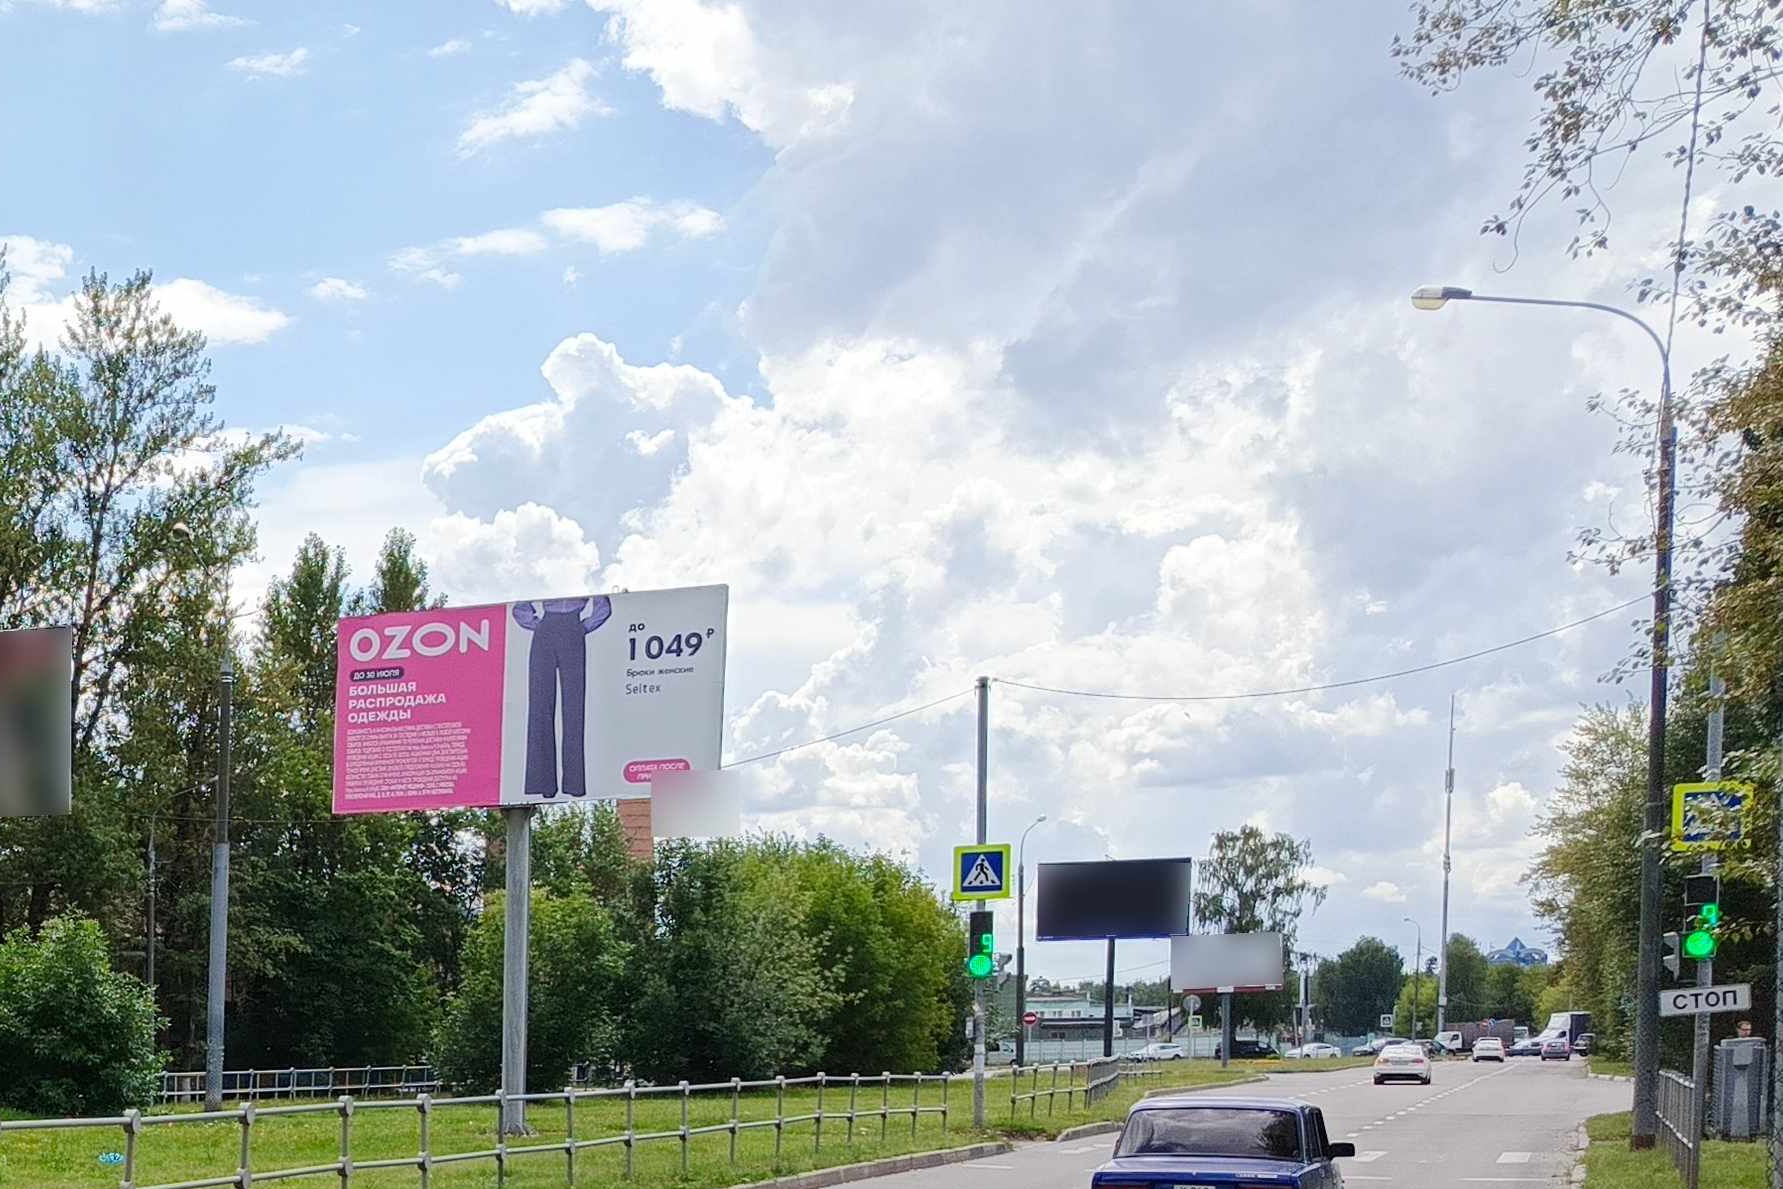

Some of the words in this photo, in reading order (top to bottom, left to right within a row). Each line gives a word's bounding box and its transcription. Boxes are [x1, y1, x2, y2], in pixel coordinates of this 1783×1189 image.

[628, 623, 646, 633] до
[349, 619, 490, 662] OZON
[353, 671, 365, 680] ДО
[626, 668, 655, 678] Брюки
[658, 667, 694, 675] женские
[348, 682, 416, 696] БОЛЬШАЯ
[625, 682, 662, 695] Seltex
[348, 693, 447, 710] РАСПРОДАЖА
[348, 710, 411, 723] ОДЕЖДЫ
[982, 933, 993, 953] 9
[1673, 990, 1738, 1010] СТОП
